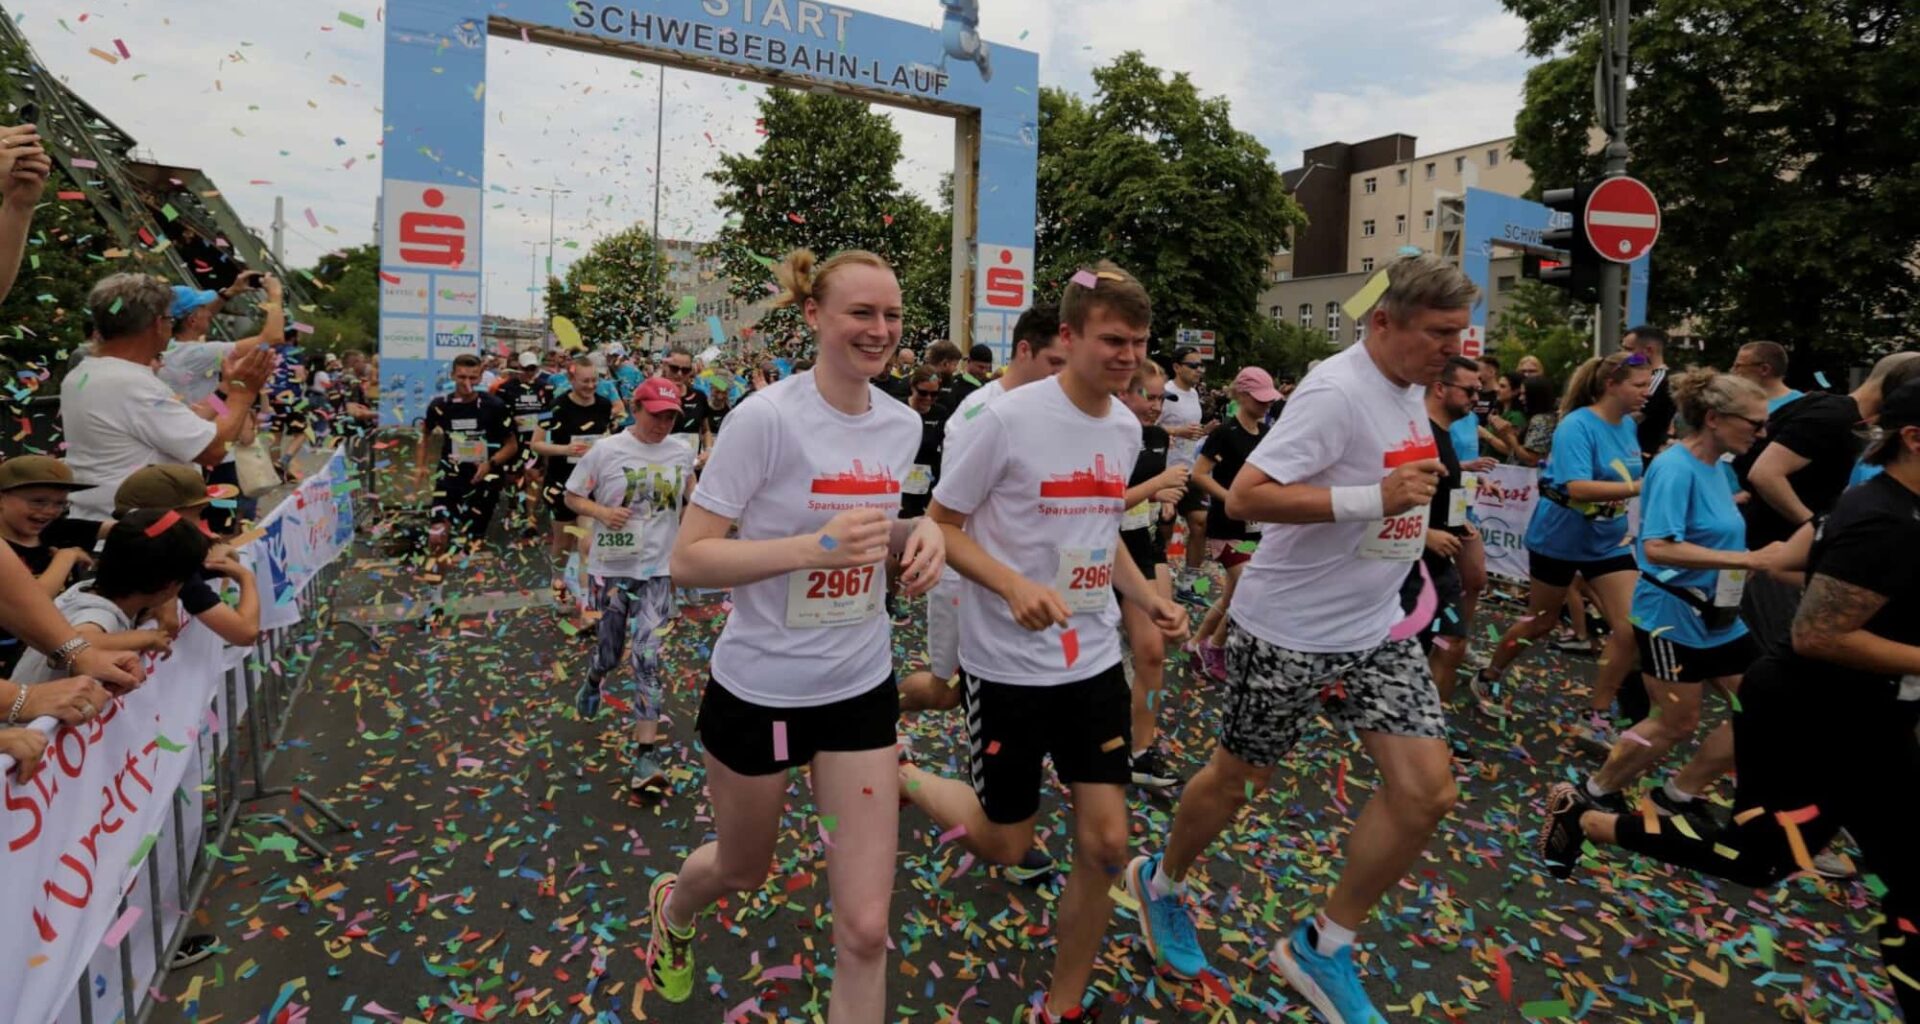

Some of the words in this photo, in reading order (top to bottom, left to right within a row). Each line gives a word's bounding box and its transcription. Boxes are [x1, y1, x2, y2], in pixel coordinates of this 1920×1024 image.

[573, 1, 949, 96] SCHWEBEBAHN-LAUF
[808, 500, 854, 512] Sparkasse
[597, 532, 635, 547] 2382
[1378, 516, 1423, 540] 2965
[806, 566, 875, 599] 2967
